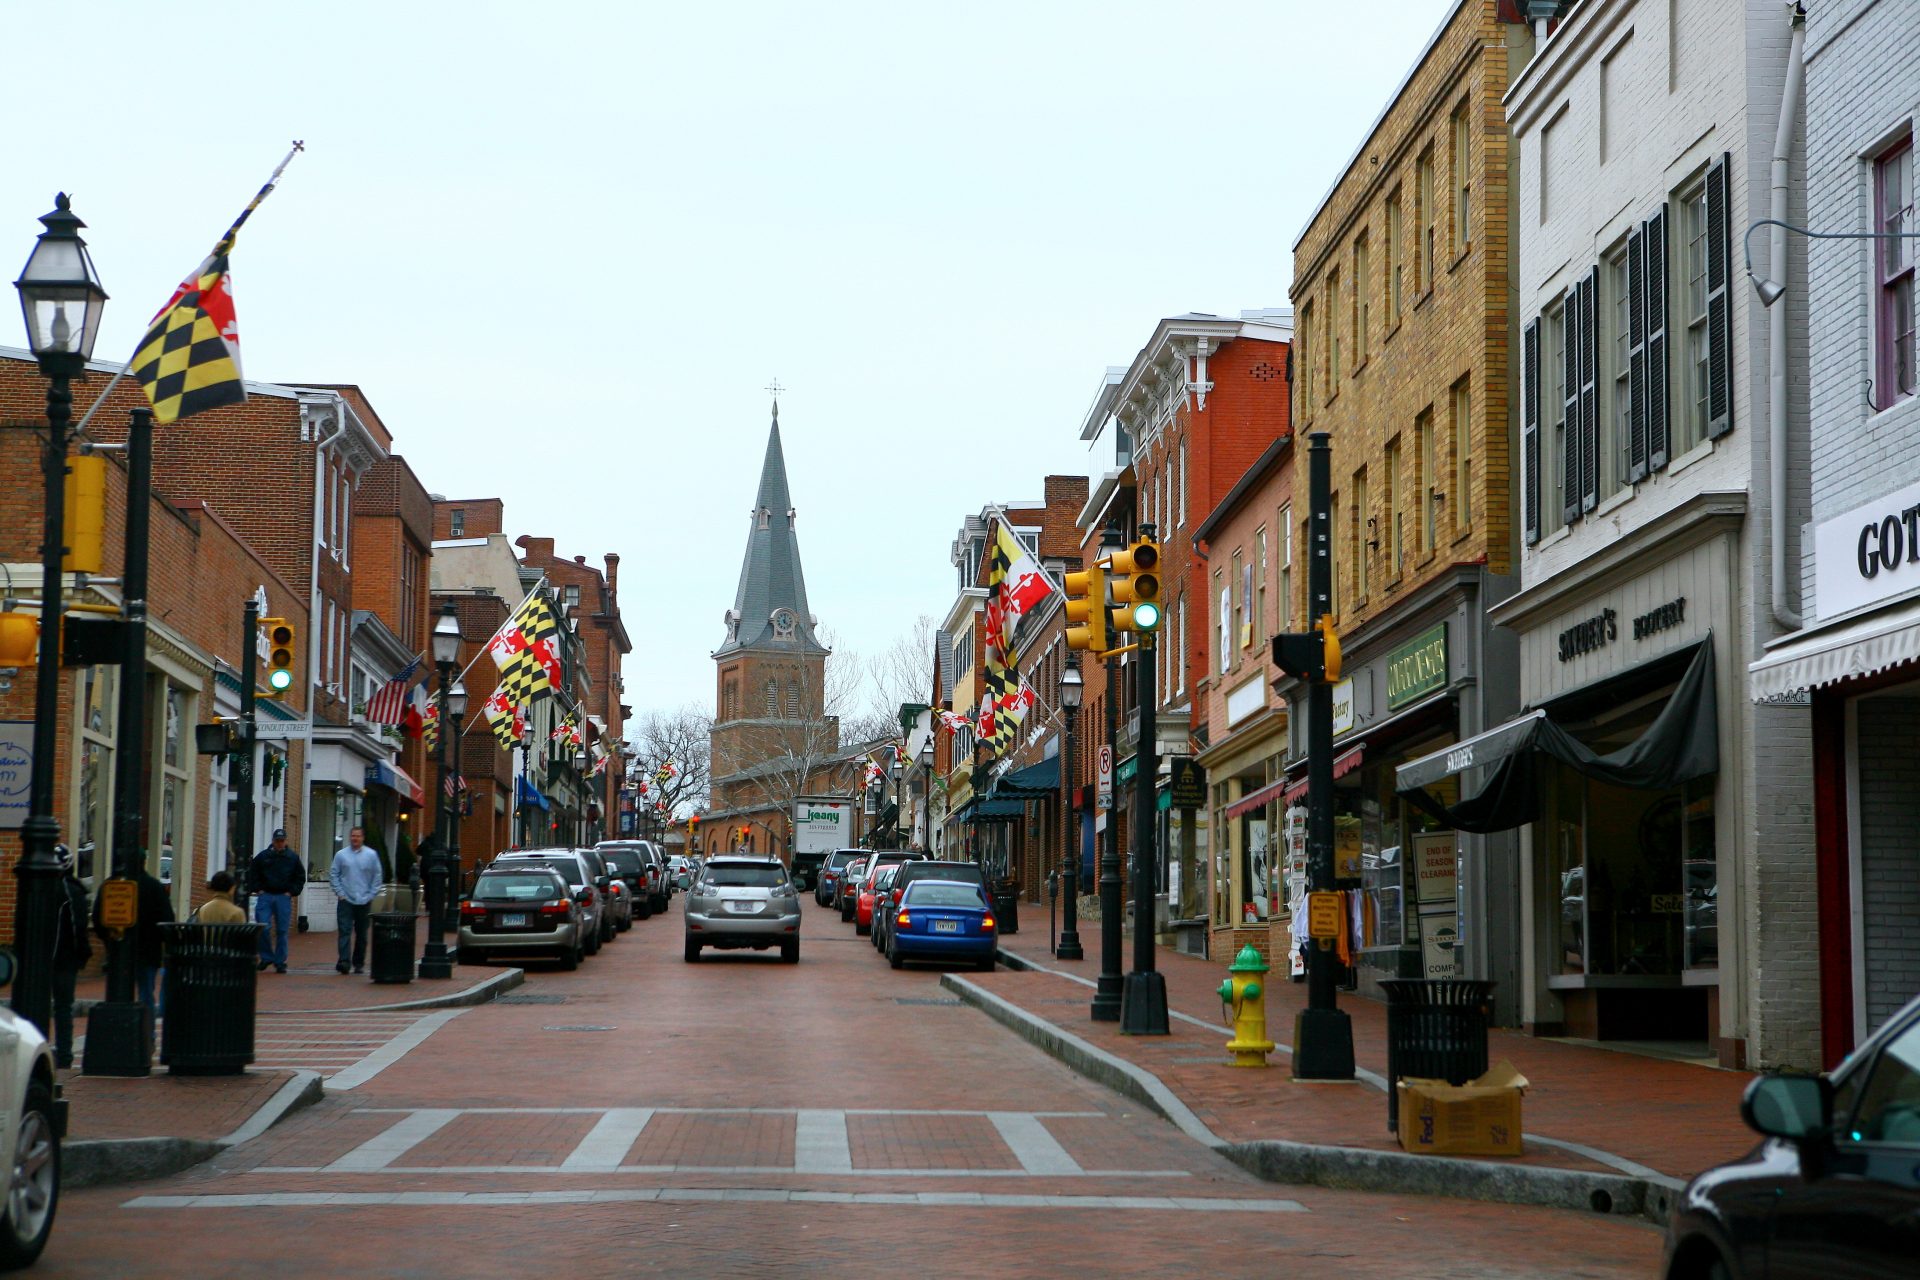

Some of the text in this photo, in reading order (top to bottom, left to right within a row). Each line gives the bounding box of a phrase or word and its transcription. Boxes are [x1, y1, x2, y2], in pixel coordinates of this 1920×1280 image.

[1558, 596, 1686, 663] SNYDER'S BOOTERY
[257, 723, 309, 731] CONDUIT STREET
[1426, 846, 1451, 856] END OF
[1426, 858, 1455, 867] SEASON
[1420, 869, 1456, 879] CLEARANC
[1428, 964, 1456, 973] COMF
